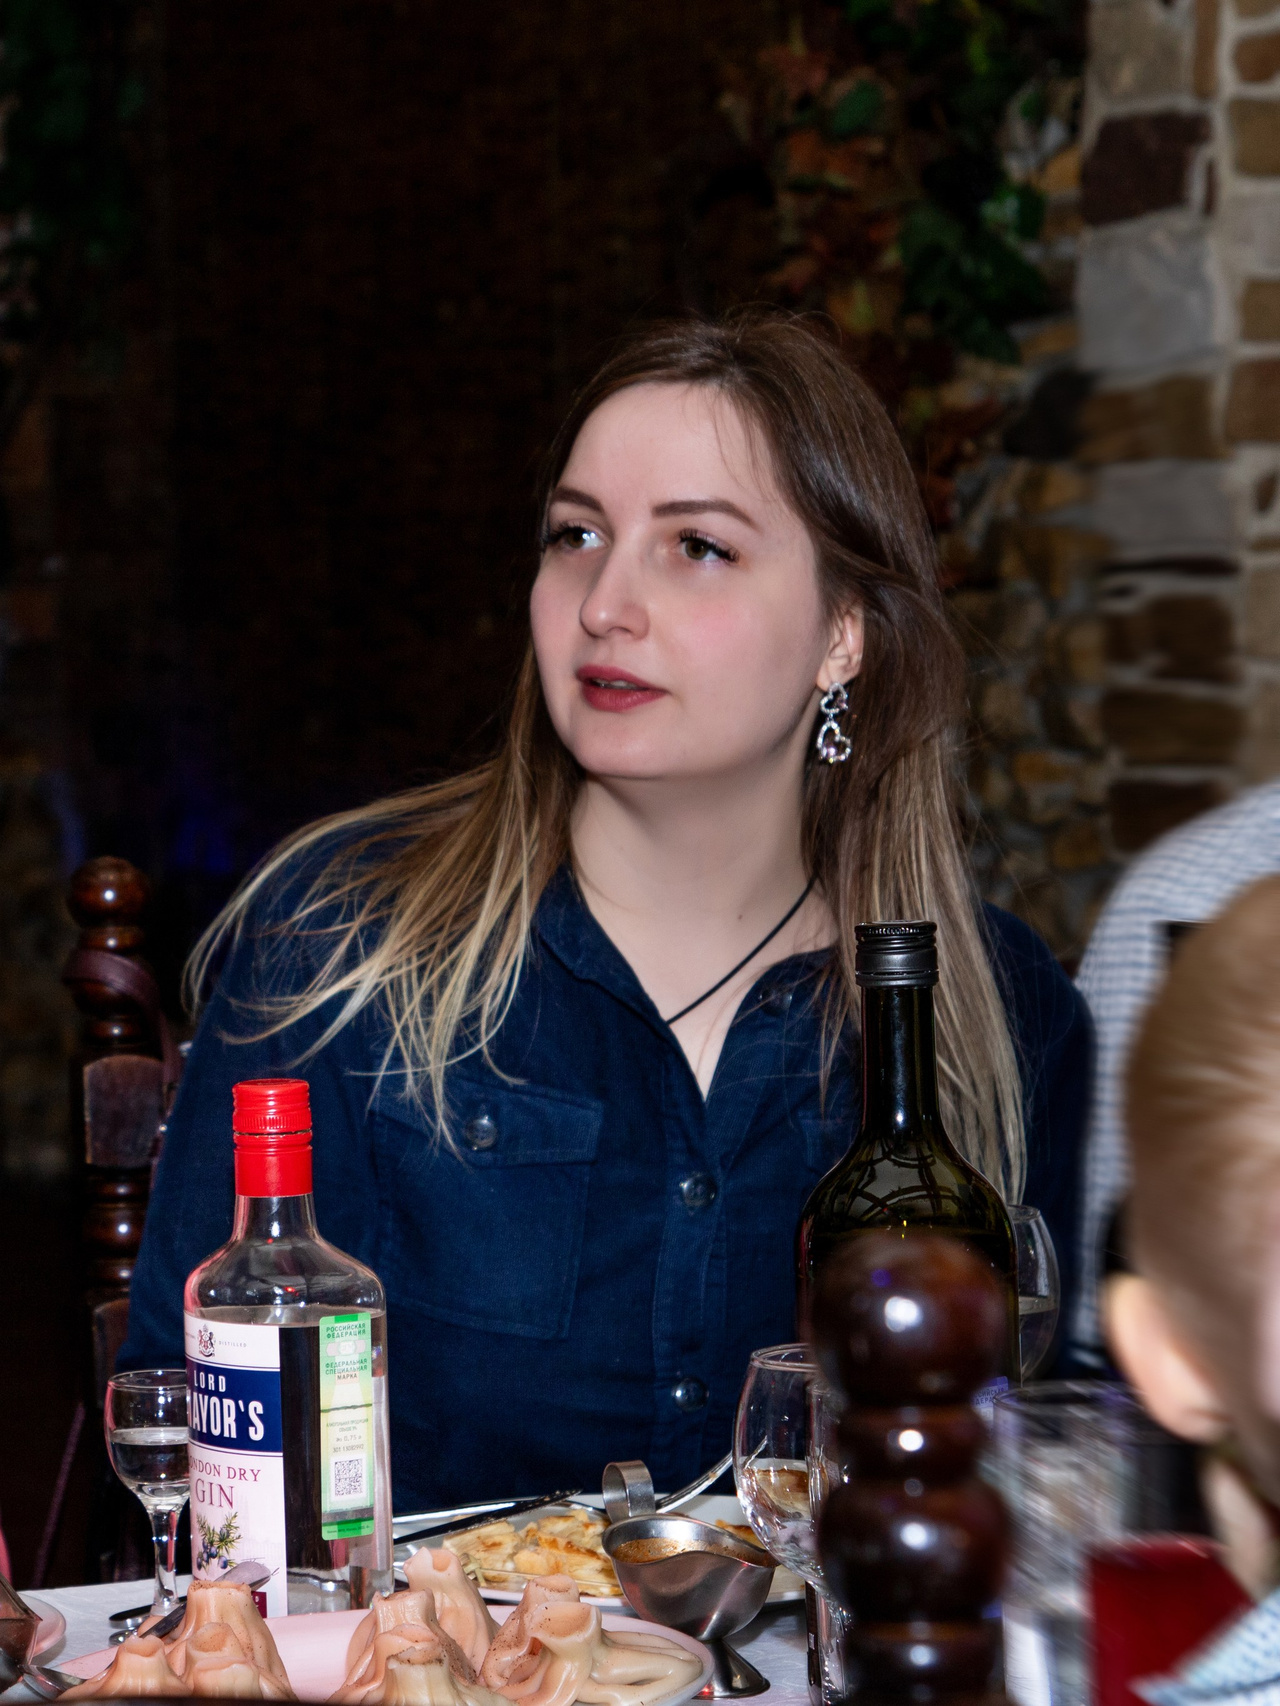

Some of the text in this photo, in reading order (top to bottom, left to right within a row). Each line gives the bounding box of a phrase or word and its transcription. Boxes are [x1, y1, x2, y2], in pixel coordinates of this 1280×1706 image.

[326, 1322, 366, 1333] РОССИЙСКАЯ
[326, 1329, 366, 1339] ФЕДЕРАЦИЯ
[193, 1369, 227, 1393] LORD
[337, 1373, 358, 1381] МАРКА
[227, 1466, 261, 1482] DRY
[195, 1478, 234, 1509] GIN
